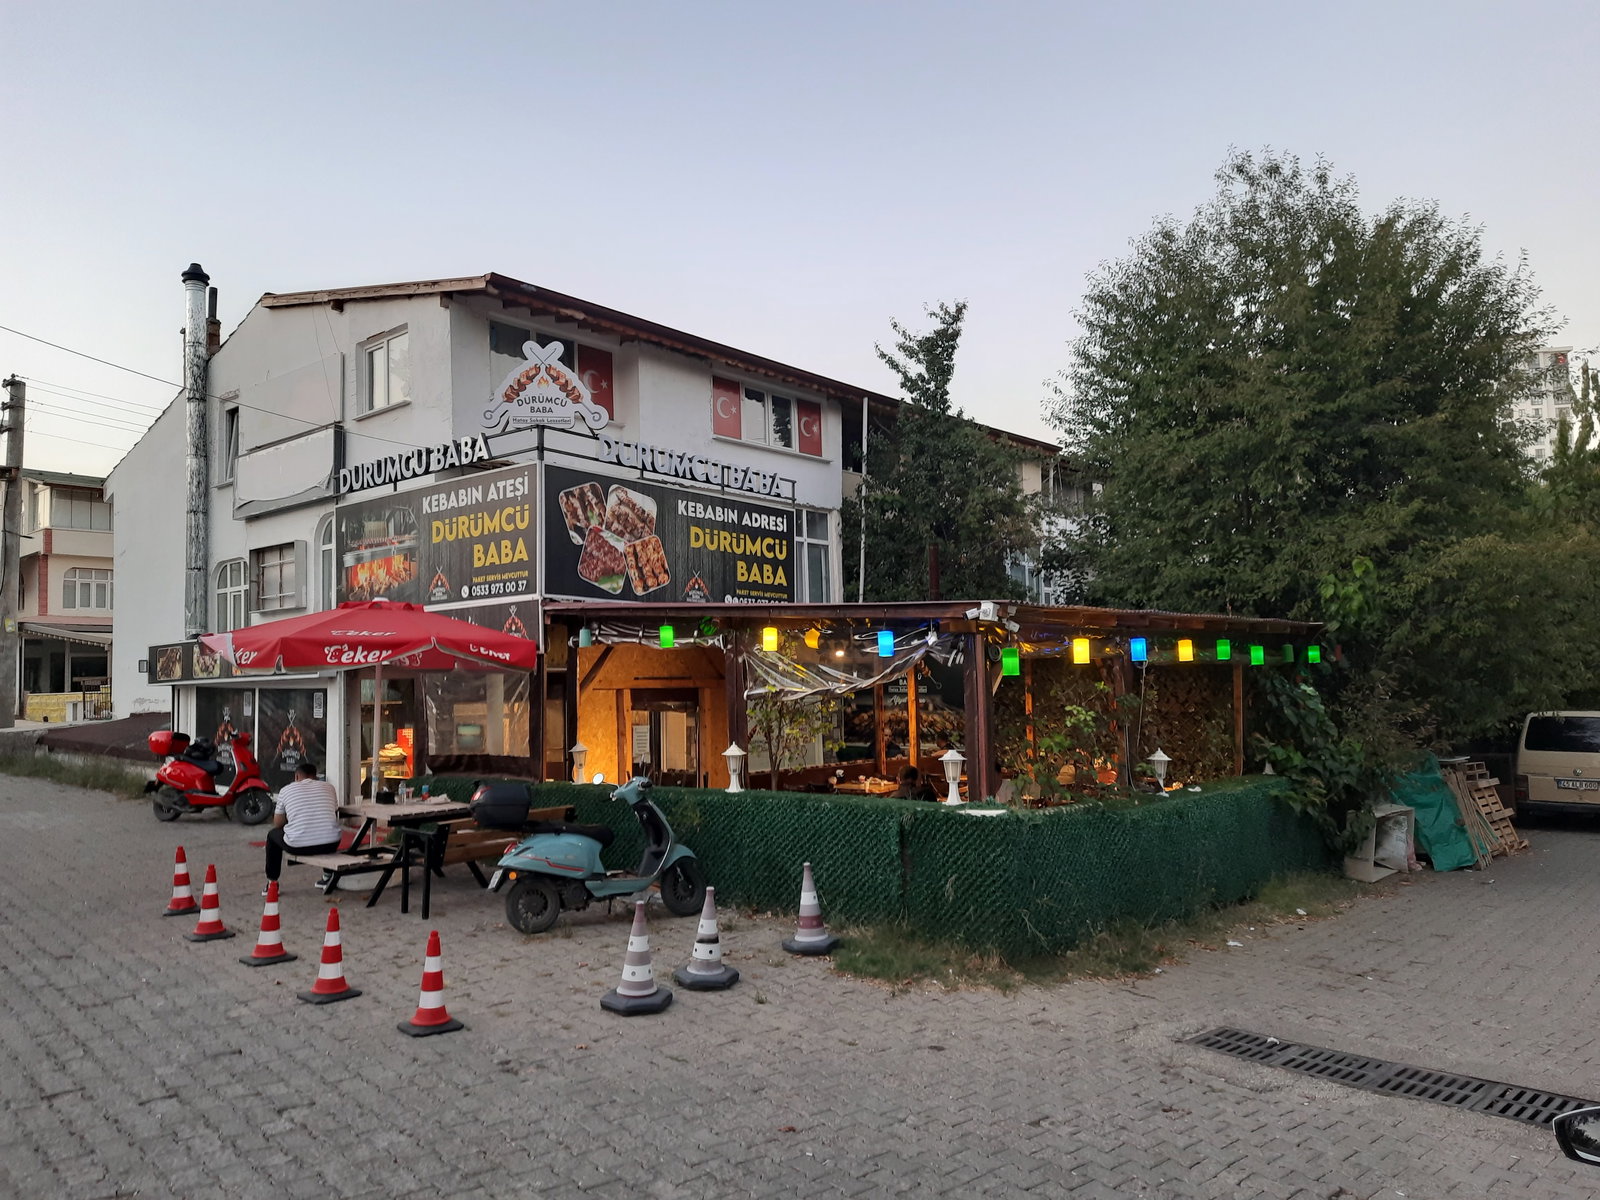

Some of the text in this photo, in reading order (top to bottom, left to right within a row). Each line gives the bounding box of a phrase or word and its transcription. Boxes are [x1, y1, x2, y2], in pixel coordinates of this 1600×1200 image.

[530, 406, 554, 414] BABA
[430, 433, 490, 472] BABA
[422, 472, 528, 514] KEBABIN ATEŞİ
[729, 464, 786, 497] BABA
[432, 504, 529, 544] DÜRÜMCÜ
[678, 500, 787, 532] KEBABIN ADRESİ
[473, 537, 528, 568] BABA
[690, 526, 787, 560] DÜRÜMCÜ
[472, 580, 527, 596] 0533 973 00 37
[737, 560, 788, 586] BABA
